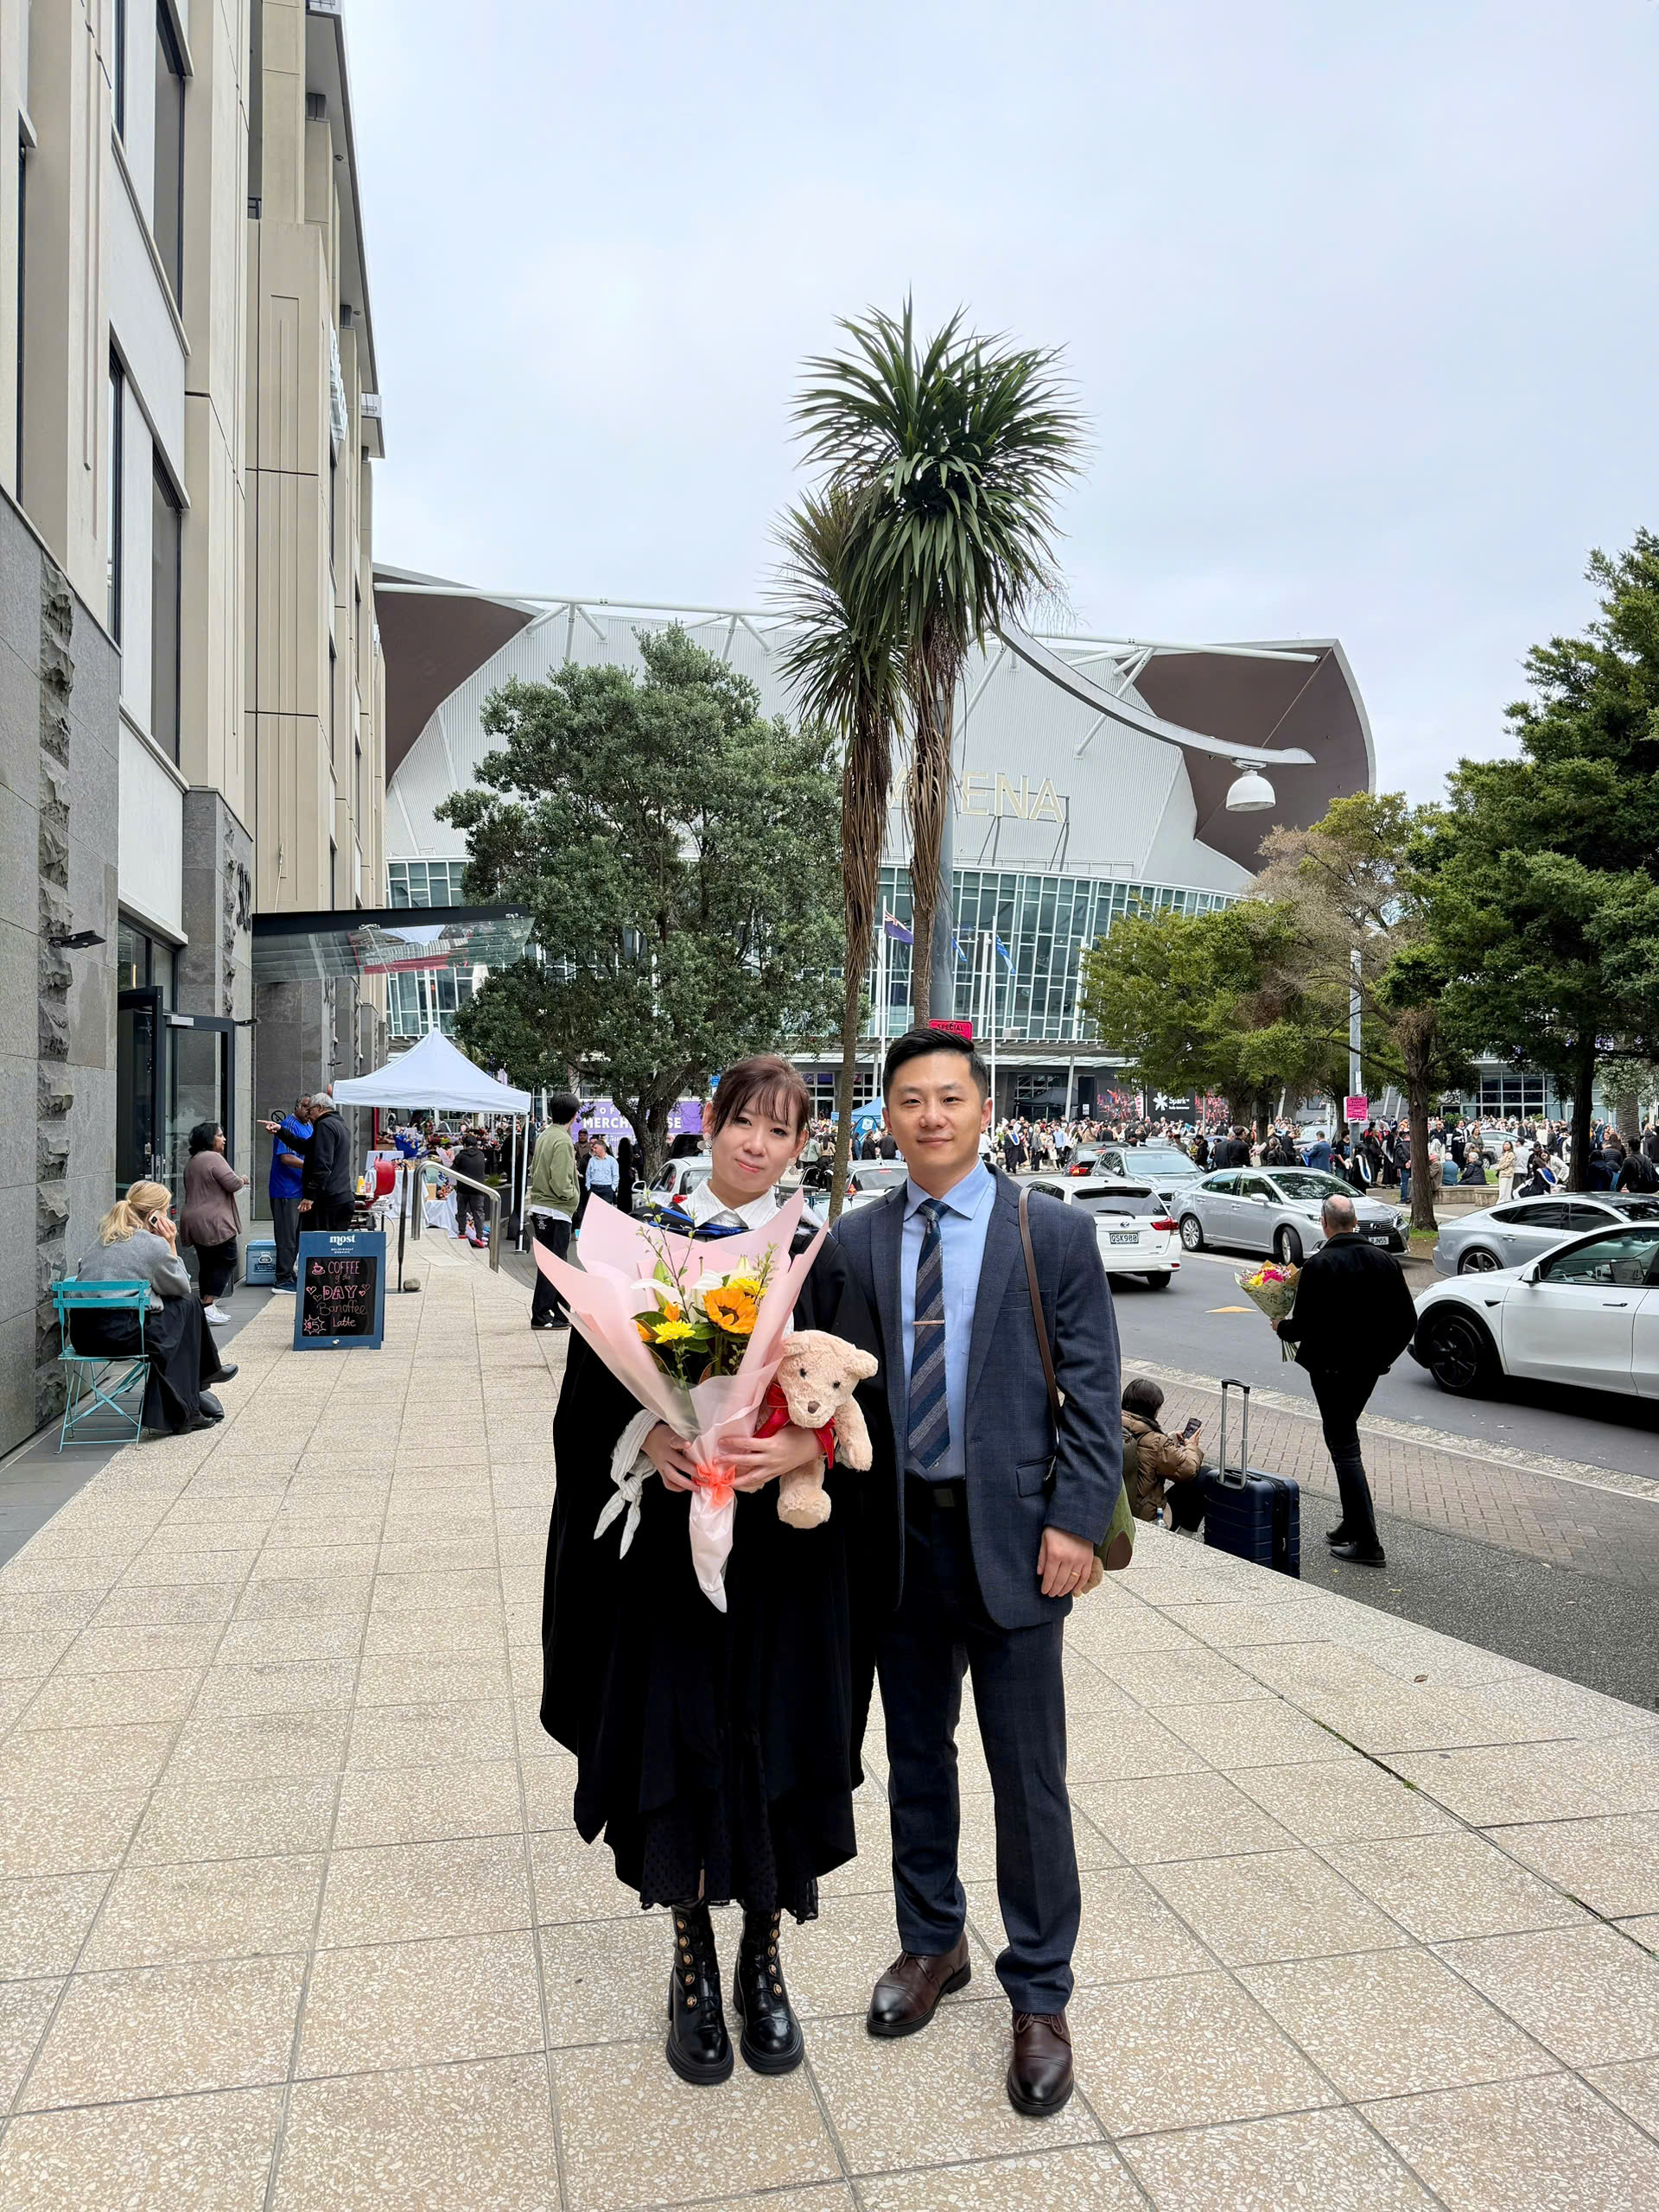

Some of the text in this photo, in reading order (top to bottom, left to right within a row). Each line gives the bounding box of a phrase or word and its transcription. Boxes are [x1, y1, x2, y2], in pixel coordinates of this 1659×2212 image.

[887, 765, 1065, 823] AENA
[1168, 1096, 1186, 1106] Spark
[583, 1116, 682, 1128] MERCHSE
[329, 1234, 355, 1245] most
[327, 1261, 360, 1274] COFFEE
[322, 1285, 358, 1301] DAY
[316, 1300, 367, 1316] Banoffee
[307, 1321, 320, 1331] $5
[332, 1316, 356, 1328] Latte
